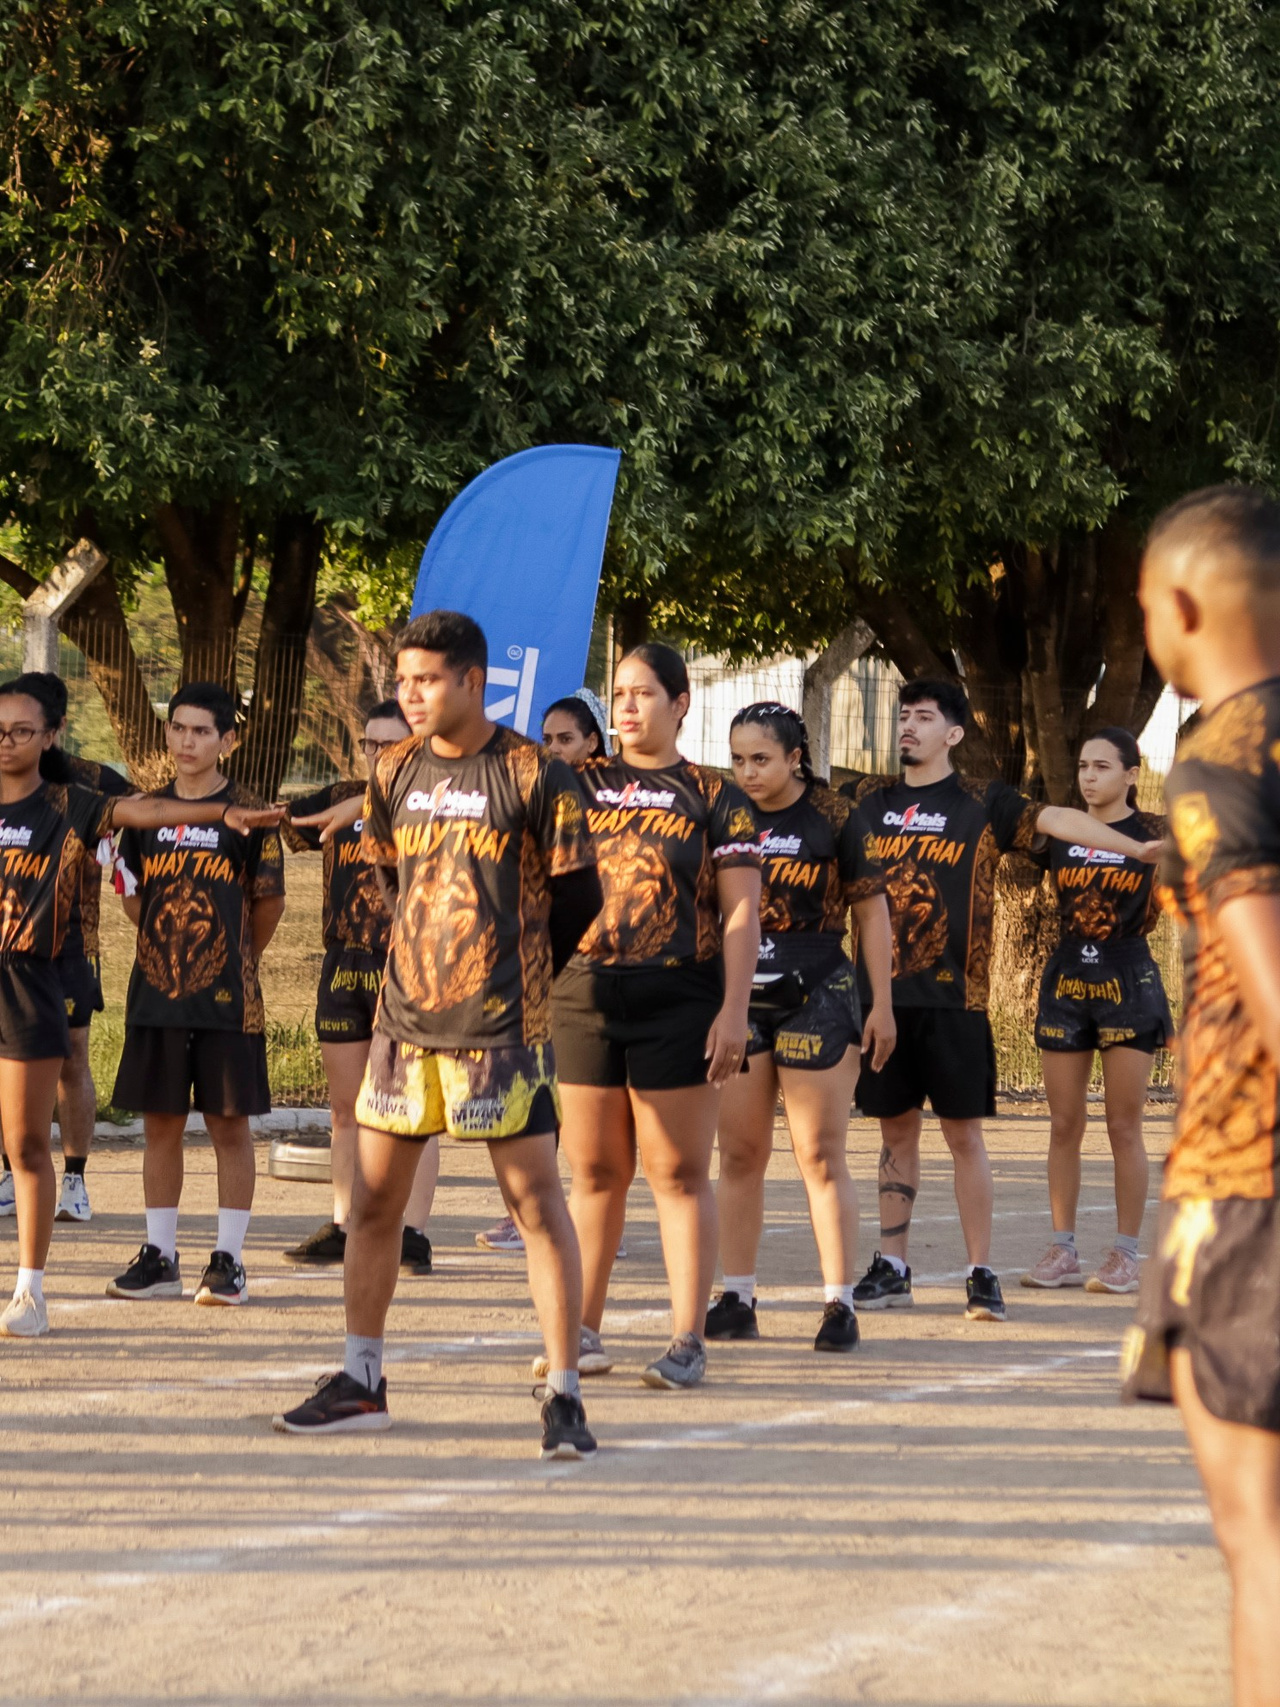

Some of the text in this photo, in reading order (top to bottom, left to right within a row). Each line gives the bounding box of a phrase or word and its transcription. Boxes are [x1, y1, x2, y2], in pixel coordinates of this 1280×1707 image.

[451, 820, 511, 865] THAI
[639, 808, 696, 844] THAI
[3, 848, 51, 882] THAI
[192, 851, 235, 886] THAI
[918, 835, 966, 868] THAI
[768, 857, 821, 890] THAI
[1101, 867, 1144, 895] THAI
